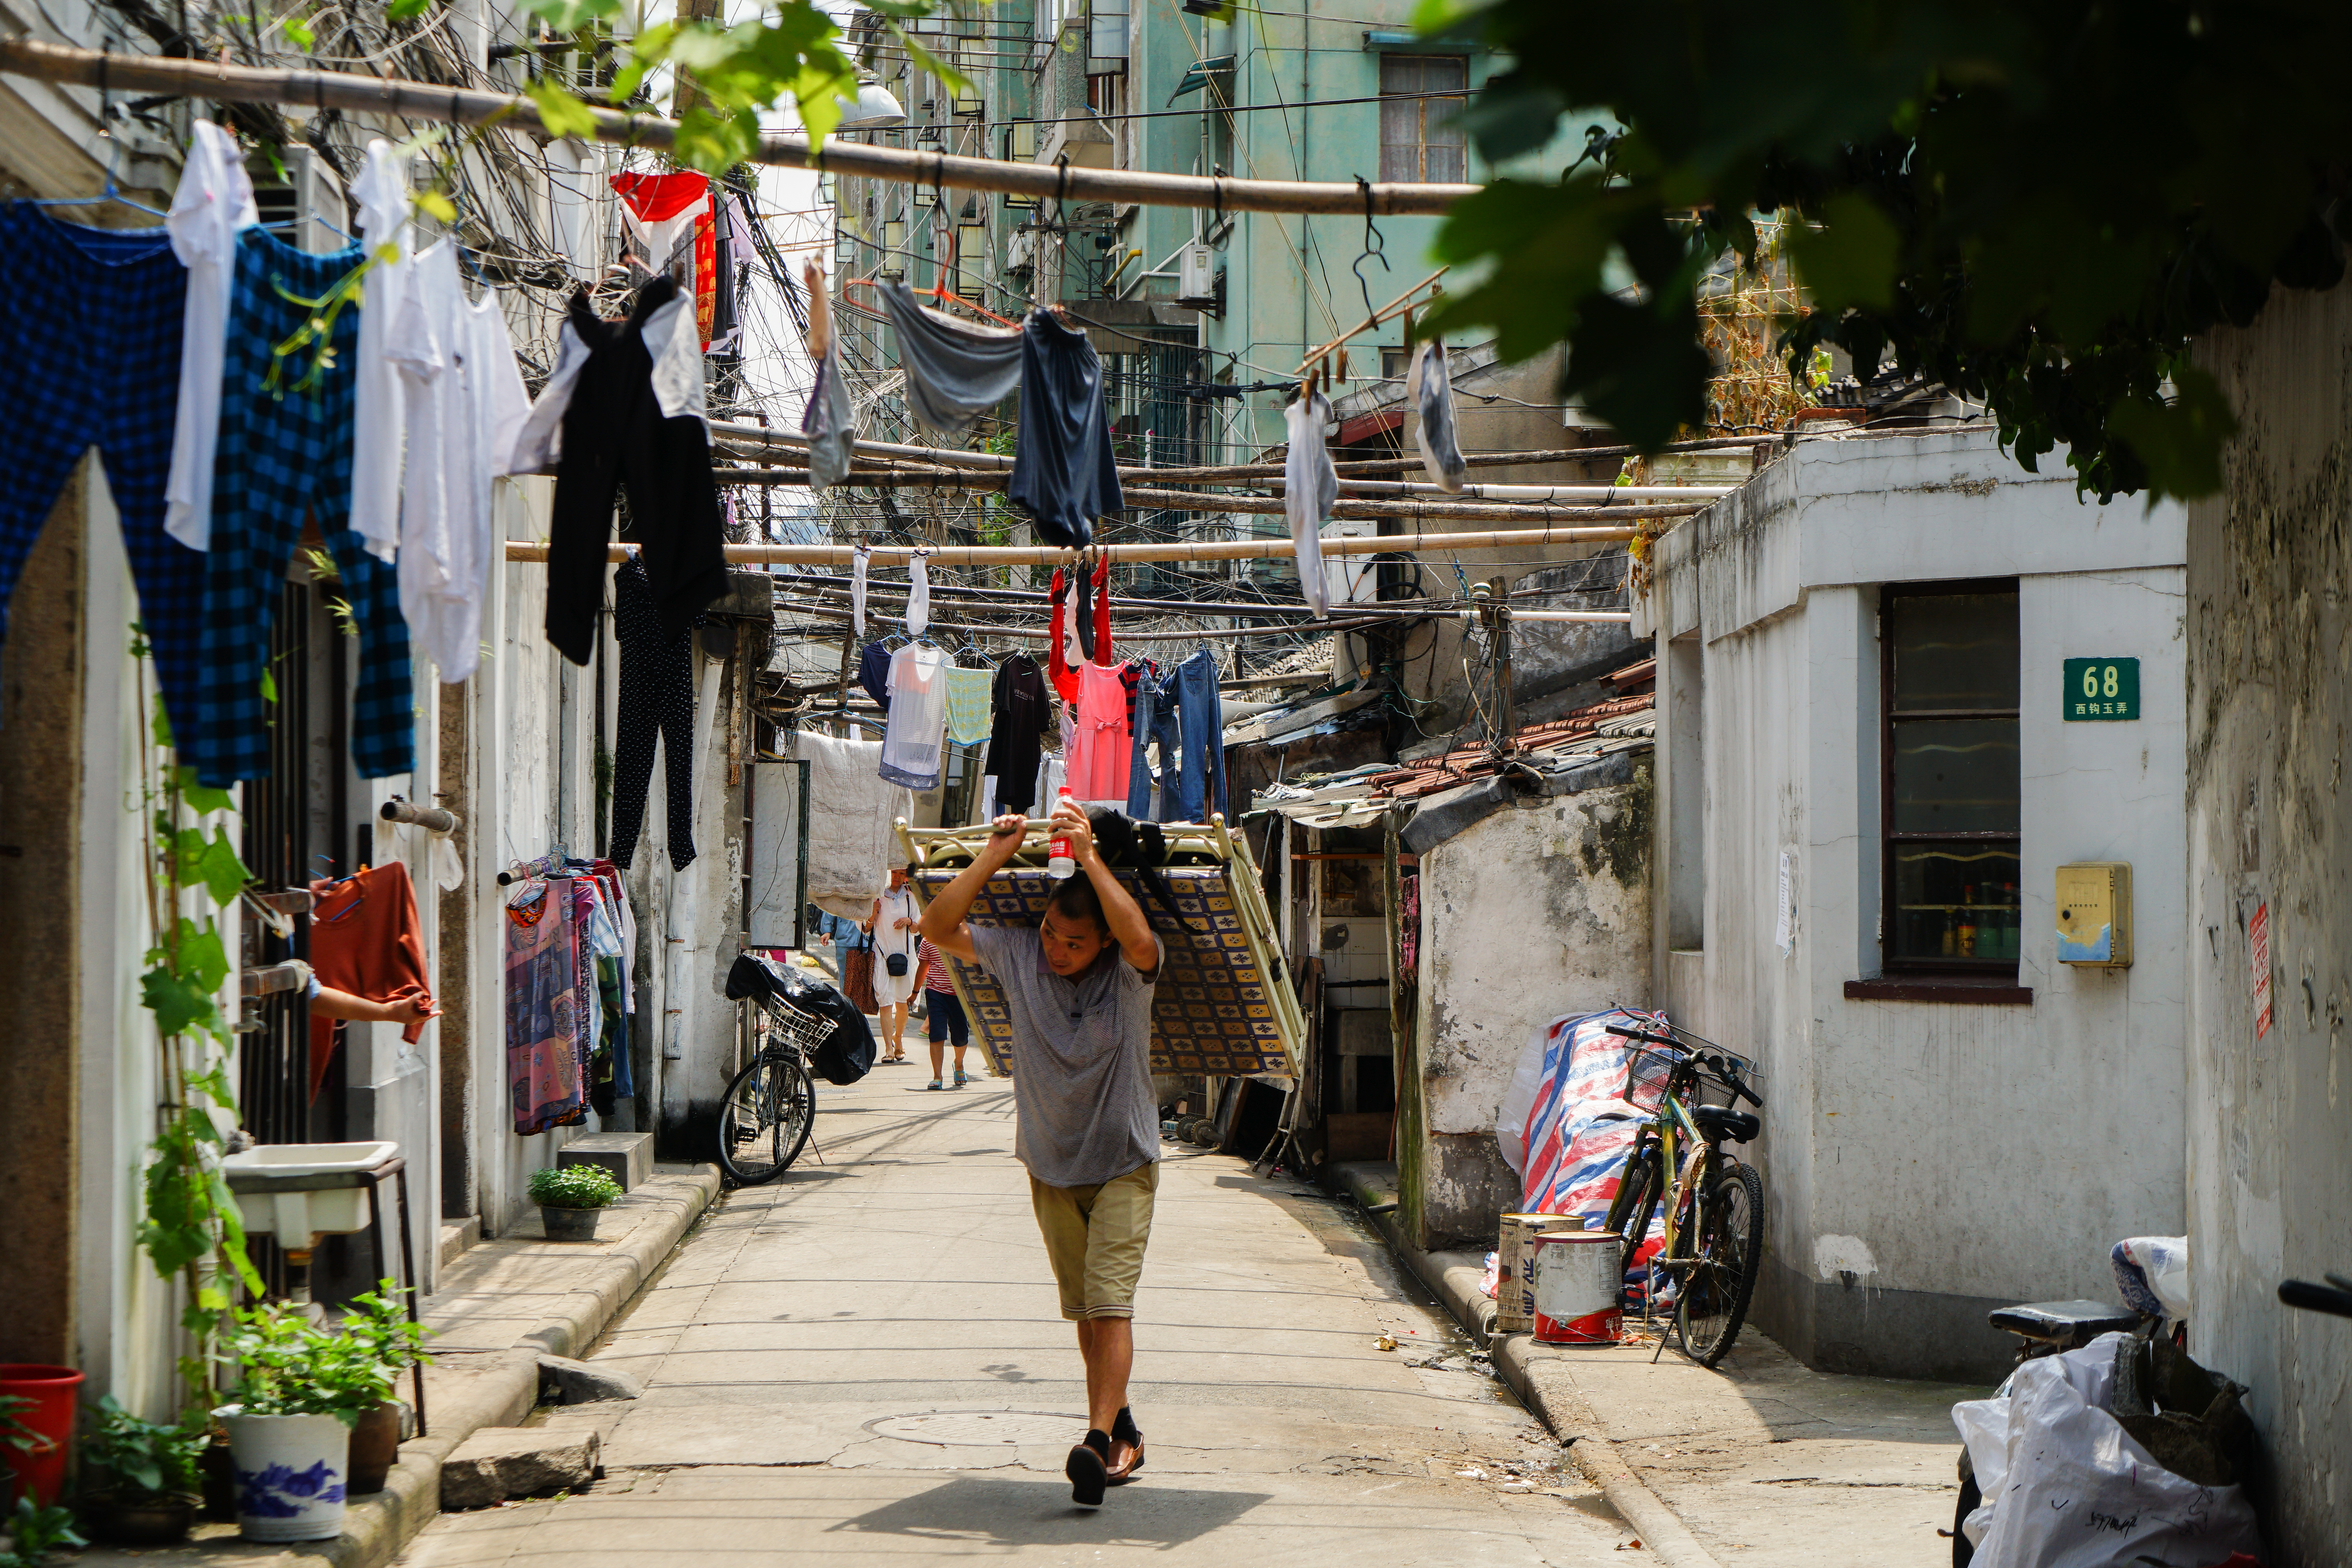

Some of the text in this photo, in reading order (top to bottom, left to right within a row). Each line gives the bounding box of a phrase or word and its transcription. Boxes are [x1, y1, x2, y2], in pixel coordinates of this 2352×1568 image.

[2083, 666, 2118, 697] 68
[2075, 702, 2127, 715] 西钩玉弄
